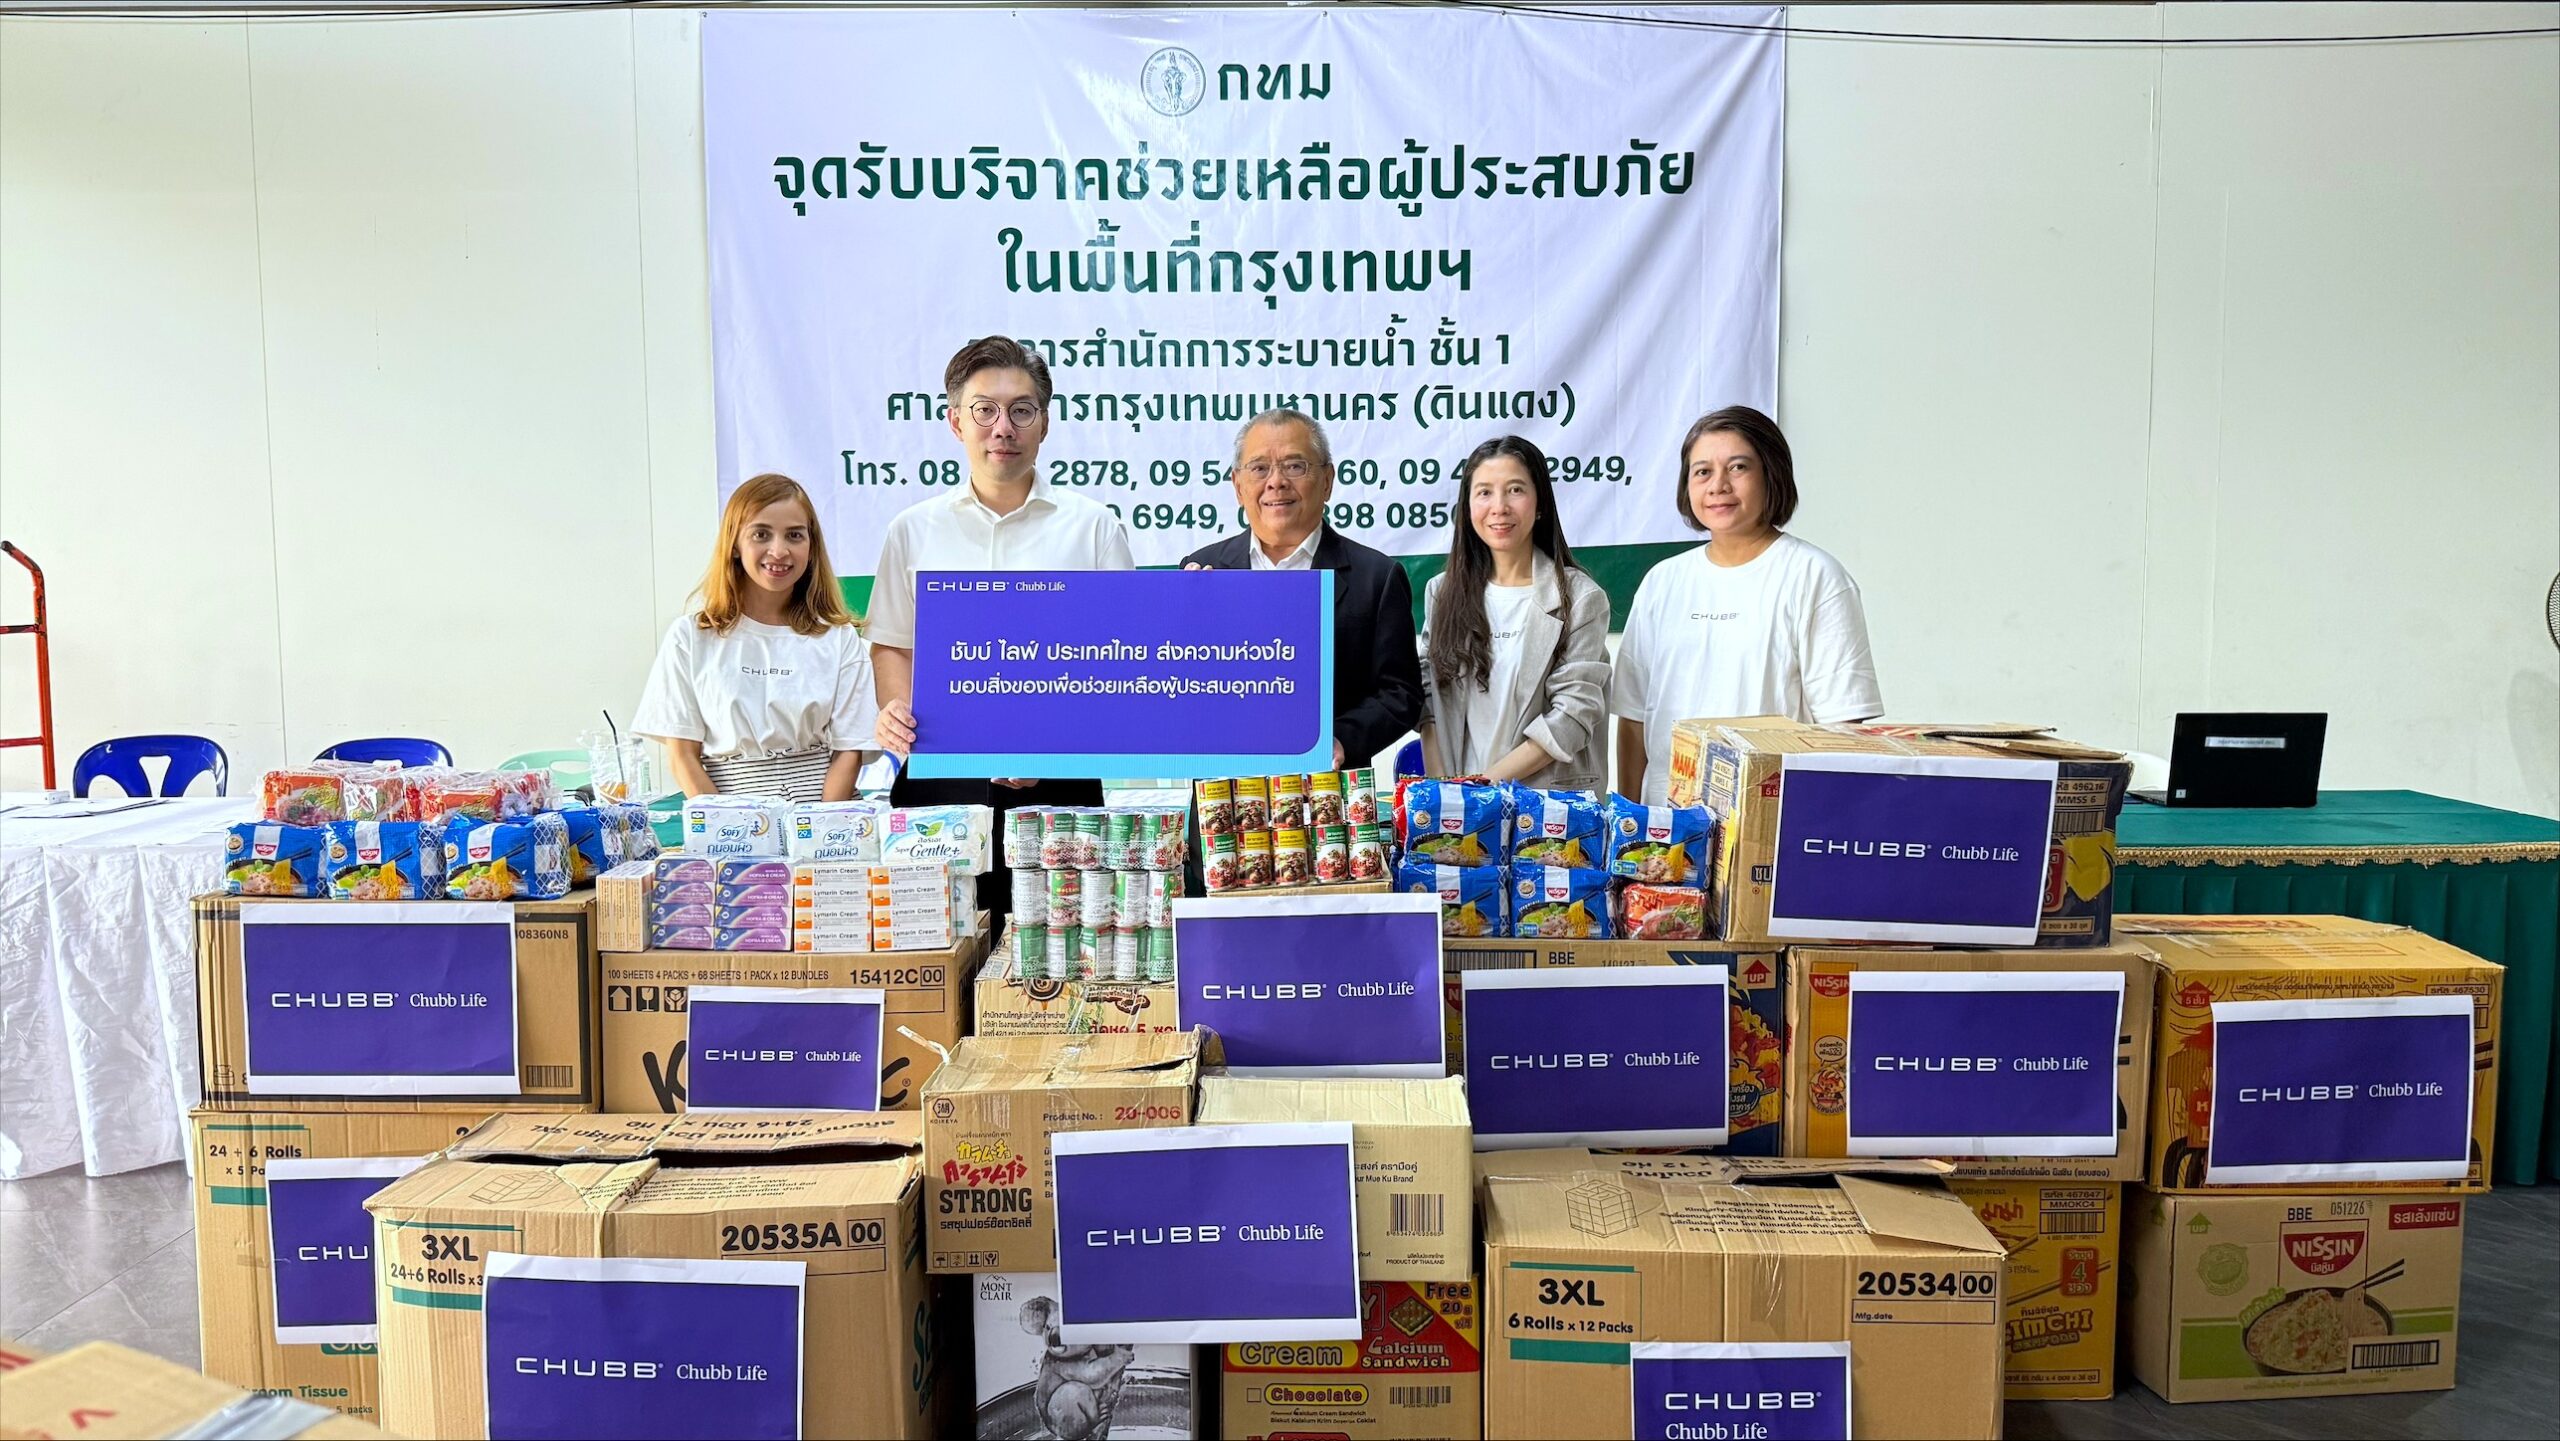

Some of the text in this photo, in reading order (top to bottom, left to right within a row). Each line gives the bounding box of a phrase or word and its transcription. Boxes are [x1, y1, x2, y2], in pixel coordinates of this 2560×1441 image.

[1218, 63, 1331, 101] กทม
[774, 138, 1695, 218] จุดรับบริจาคช่วยเหลือผู้ประสบภัย
[998, 218, 1472, 310] ในพื้นที่กรุงเทพฯ
[1430, 316, 1481, 367] ชั้น
[1495, 334, 1510, 365] 1
[1414, 381, 1577, 429] (ดินแดง)
[841, 450, 908, 486] โทร.
[918, 460, 961, 486] 08
[1049, 460, 1138, 491] 2878,
[1149, 460, 1191, 486] 09
[1399, 458, 1441, 485] 09
[1132, 503, 1225, 534] 6949,
[927, 581, 1066, 592] CHUBB Chubb Life
[1690, 613, 1738, 621] CHUBB
[950, 639, 1295, 662] ชับบ์ ไลฟ์ ประเทศไทย ส่งความห่วงใย
[949, 672, 1295, 700] มอบสิ่งของเพื่อช่วยเหลือผู้ประสบอุทกภัย
[1804, 838, 2019, 862] CHUBB Chubb Life
[515, 929, 569, 940] 08360N8
[1549, 952, 1575, 965] BBE
[608, 970, 621, 980] 100
[623, 969, 654, 980] SHEETS
[663, 970, 689, 980] PACKS
[698, 970, 708, 980] 68
[710, 970, 741, 980] SHEETS
[750, 970, 771, 980] PACK
[780, 970, 789, 980] 12
[791, 970, 829, 981] BUNDLES
[850, 968, 943, 985] 15412C 00
[1750, 974, 1765, 983] UP
[1203, 981, 1415, 999] CHUBB Chubb Life
[271, 993, 488, 1008] CHUBB Chubb Life
[705, 1050, 862, 1062] CHUBB Chubb Life
[1491, 1051, 1700, 1070] CHUBB Chubb Life
[1875, 1056, 2089, 1072] CHUBB Chubb Life
[2239, 1082, 2443, 1102] CHUBB Chubb Life
[1043, 1106, 1181, 1122] Product No. 20-006
[209, 1145, 227, 1157] 24
[249, 1145, 259, 1158] 6
[265, 1145, 302, 1158] Rolls
[237, 1165, 245, 1176] 5
[1365, 1175, 1414, 1183] Mue Ku Brand
[939, 1187, 1033, 1214] STRONG
[2287, 1202, 2366, 1221] BBE 051226
[721, 1222, 883, 1252] 20535A 00
[1087, 1224, 1324, 1247] CHUBB Chubb Life
[299, 1245, 369, 1261] CHU
[420, 1234, 480, 1262] 3XL
[2292, 1235, 2356, 1261] NISSIN
[390, 1262, 425, 1284] 24+6
[427, 1267, 466, 1286] Rolls
[2072, 1262, 2086, 1282] 4
[980, 1282, 1012, 1292] MONT
[1425, 1282, 1472, 1299] Free
[1538, 1278, 1605, 1307] 3XL
[1857, 1271, 1994, 1297] 20534 00
[980, 1291, 1012, 1301] CLAIR
[1441, 1302, 1460, 1314] 20
[1854, 1312, 1894, 1322] Mfg.date
[1508, 1312, 1520, 1329] 6
[1524, 1315, 1564, 1331] Rolls
[1579, 1320, 1596, 1332] 12
[1599, 1321, 1634, 1334] Packs
[2006, 1308, 2092, 1342] IMCHI
[1239, 1342, 1343, 1366] Cream
[1367, 1336, 1444, 1355] Calcium
[515, 1357, 768, 1382] CHUBB Chubb Life
[1361, 1355, 1451, 1369] Sandwich
[299, 1385, 348, 1398] Tissue
[1270, 1387, 1363, 1402] Chocolate
[347, 1406, 373, 1416] packs
[1665, 1391, 1815, 1440] CHUBB Chubb Life
